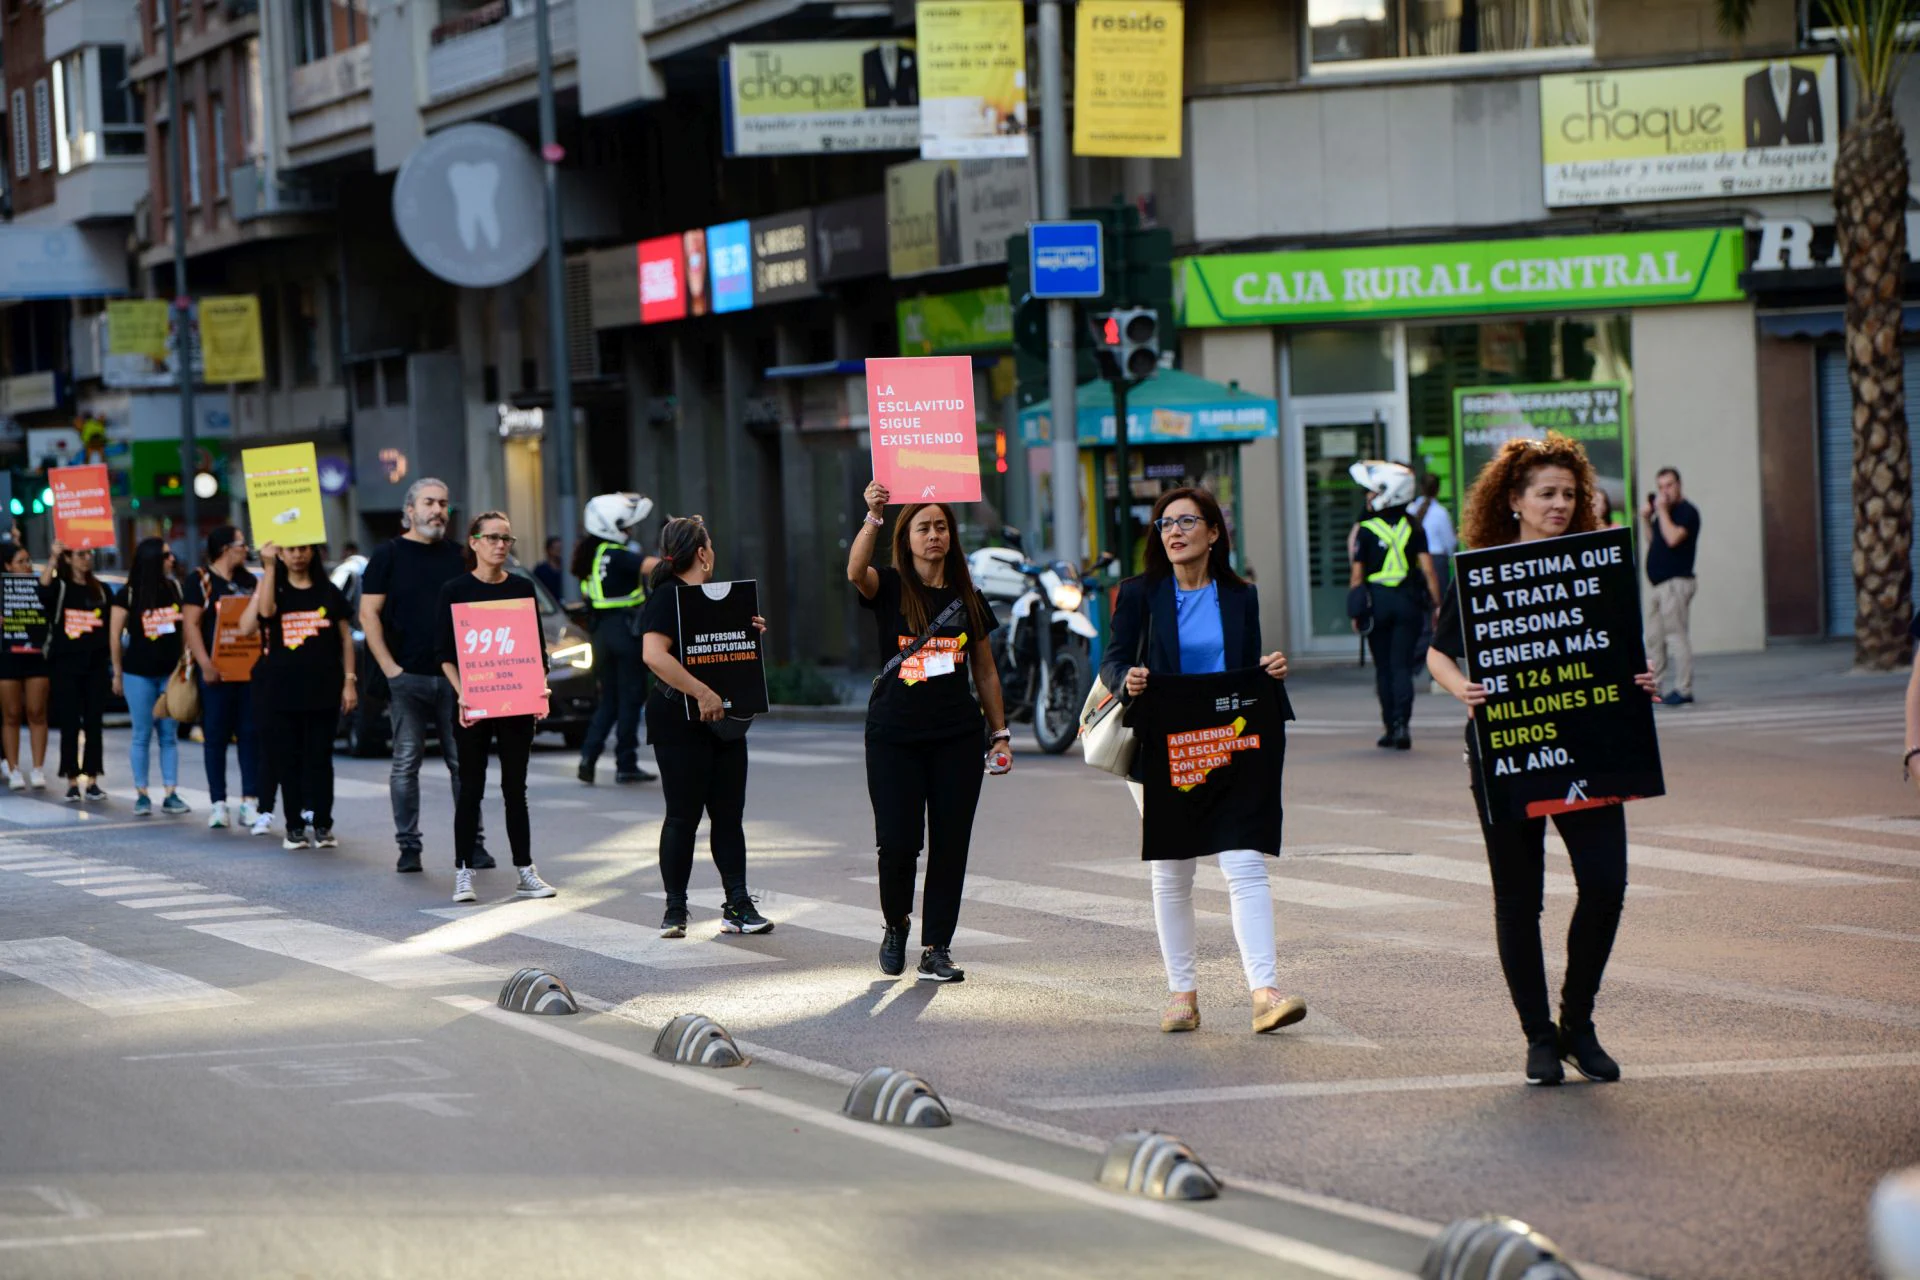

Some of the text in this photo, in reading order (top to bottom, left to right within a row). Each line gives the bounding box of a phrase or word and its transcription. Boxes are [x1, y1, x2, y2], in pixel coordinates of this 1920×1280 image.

[1091, 12, 1167, 31] reside
[1574, 78, 1619, 111] Tu
[1561, 101, 1724, 154] chaque
[1232, 251, 1691, 305] CAJA RURAL CENTRAL
[877, 385, 895, 396] LA
[878, 400, 965, 413] ESCLAVITUD
[880, 418, 921, 430] SIGUE
[881, 433, 964, 446] EXISTIENDO
[1468, 546, 1623, 587] SE ESTIMA QUE
[1472, 577, 1600, 614] LA TRATA DE
[1475, 607, 1584, 641] PERSONAS
[464, 626, 515, 655] 99%
[695, 631, 746, 643] HAY PERSONAS
[686, 641, 756, 655] SIENDO EXPLOTADAS
[1478, 628, 1610, 668] GENERA MÁS
[479, 660, 495, 668] LAS
[497, 657, 537, 666] VÍCTIMAS
[687, 651, 758, 665] EN NUESTRA CIUDAD.
[496, 671, 513, 679] SON
[902, 670, 925, 679] PASO
[1483, 662, 1593, 695] DE 126 MIL
[469, 684, 523, 693] RESCATADAS
[1486, 684, 1620, 722] MILLONES DE
[1170, 727, 1234, 746] ABOLIENDO
[1490, 723, 1558, 749] EUROS
[1171, 737, 1257, 759] LA ESCLAVITUD
[1172, 756, 1228, 772] CON CADA
[1495, 746, 1575, 776] AL AÑO.
[1173, 773, 1203, 785] PASO
